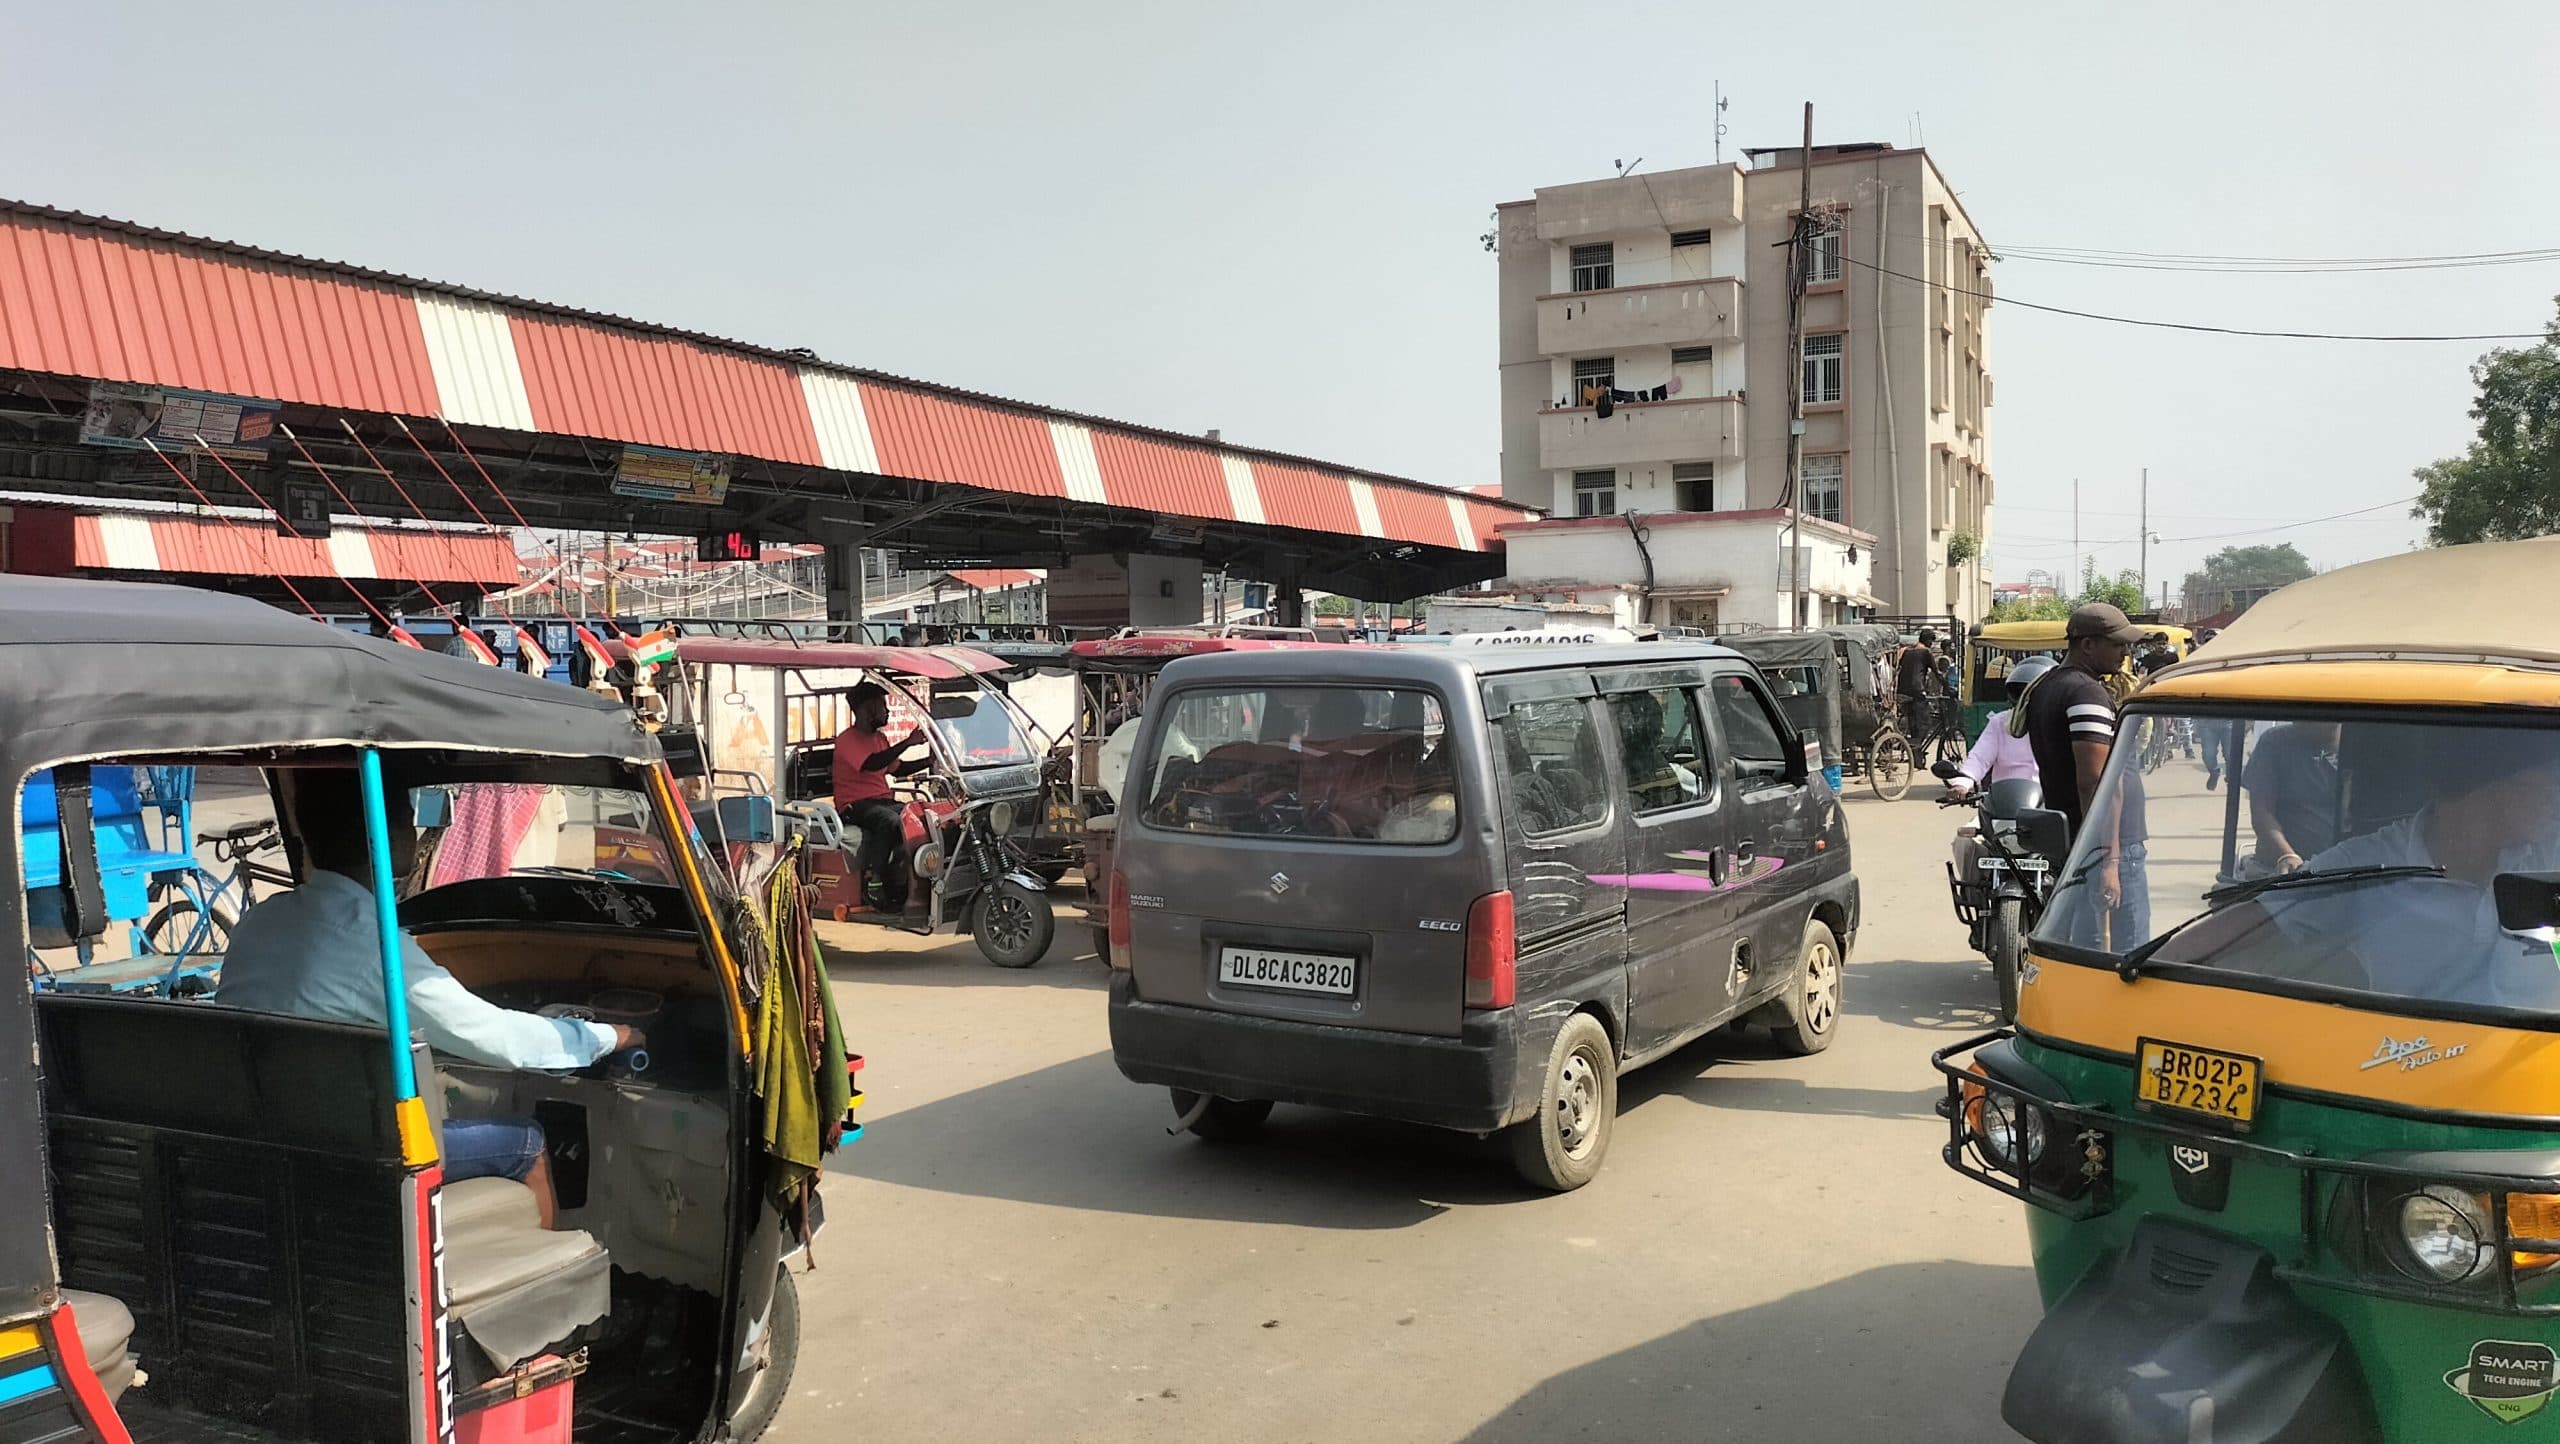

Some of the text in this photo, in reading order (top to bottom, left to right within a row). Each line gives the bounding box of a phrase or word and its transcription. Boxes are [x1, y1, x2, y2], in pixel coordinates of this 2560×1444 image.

[1130, 894, 1164, 902] MARUTI
[1130, 900, 1164, 908] SUZUKI
[1419, 920, 1461, 931] EECO
[1233, 955, 1352, 988] DL8CAC3820
[2370, 1034, 2432, 1064] Ape
[2445, 1043, 2469, 1058] HT
[2162, 1048, 2242, 1086] BR02P
[2159, 1076, 2238, 1116] B7234
[2478, 1355, 2550, 1371] SMART
[2484, 1374, 2542, 1387] TECH ENGINE
[2498, 1403, 2520, 1412] CNG
